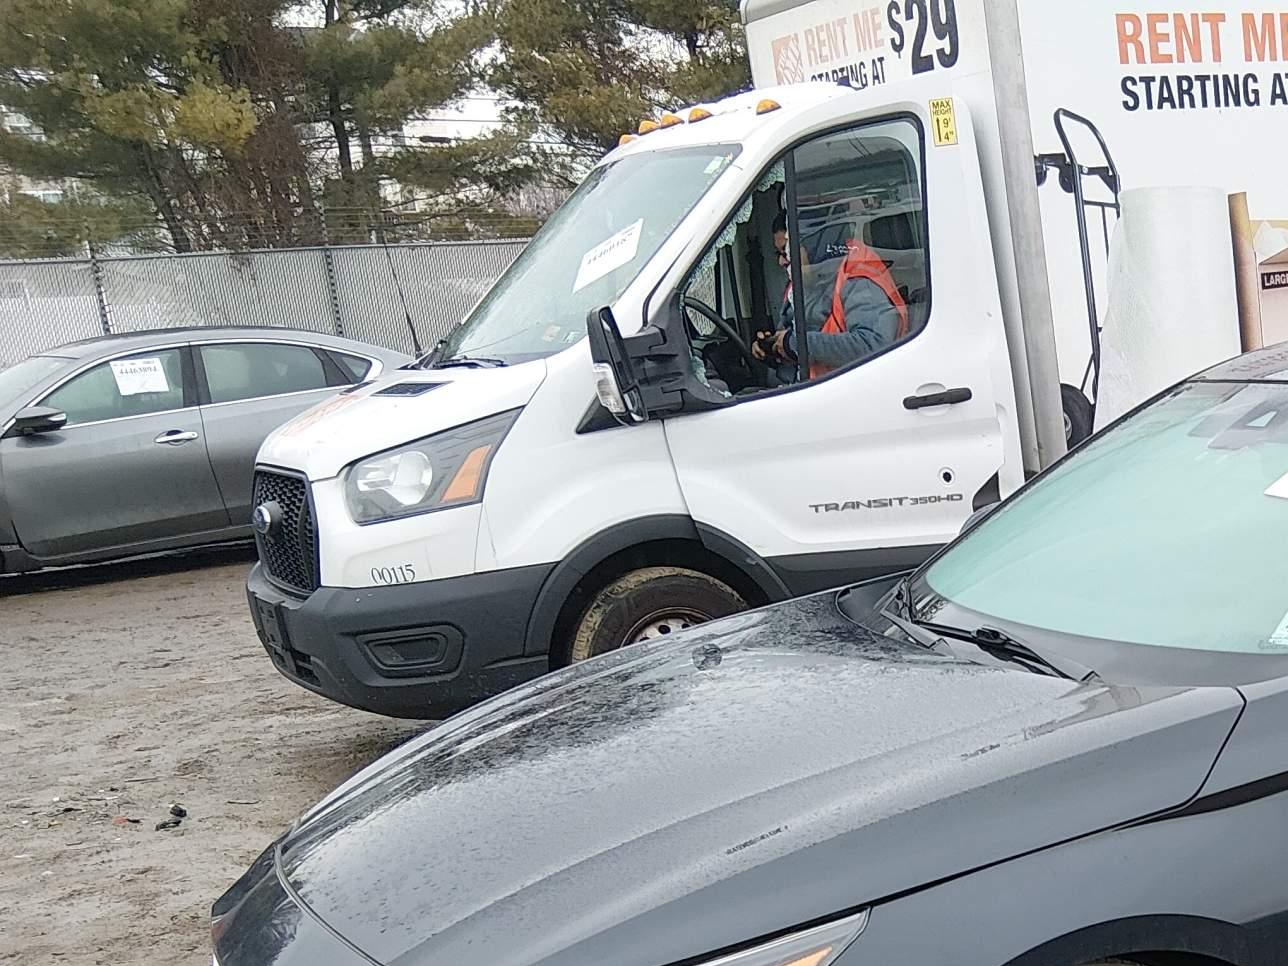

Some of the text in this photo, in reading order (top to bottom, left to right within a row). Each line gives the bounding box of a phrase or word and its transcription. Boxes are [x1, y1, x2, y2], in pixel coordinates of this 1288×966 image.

[804, 17, 849, 67] RENT
[853, 7, 885, 52] ME
[887, 0, 959, 75] $29
[1115, 13, 1226, 64] RENT
[872, 57, 886, 86] AT
[932, 100, 951, 110] MAX
[1120, 73, 1260, 111] STARTING
[933, 107, 951, 116] HEIGHT
[809, 493, 964, 513] TRANSIT 350HD
[371, 564, 416, 584] 00115
